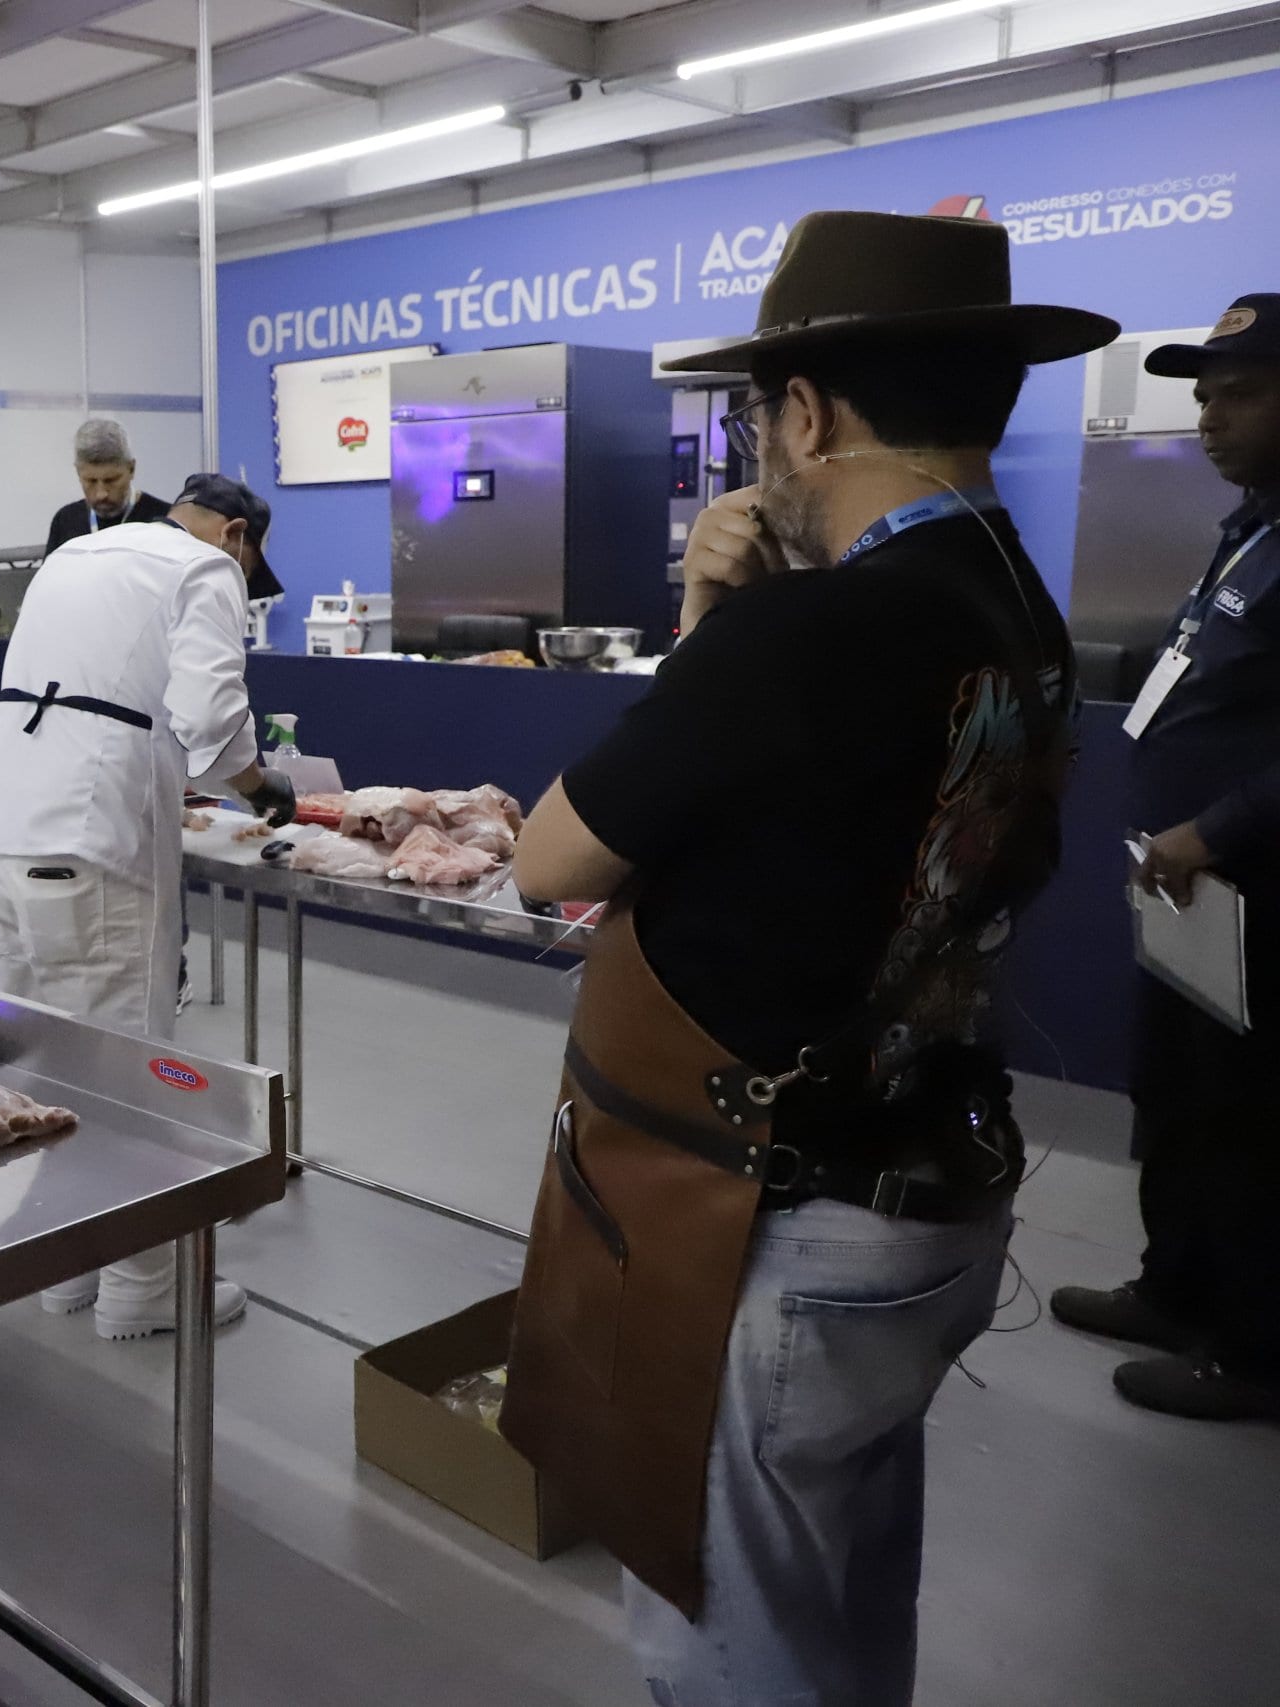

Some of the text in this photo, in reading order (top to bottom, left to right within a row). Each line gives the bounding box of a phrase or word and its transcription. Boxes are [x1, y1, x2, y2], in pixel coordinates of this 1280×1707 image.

[1002, 172, 1236, 217] CONGRESSO CONEXÕES COM
[1003, 190, 1233, 245] RESULTADOS
[699, 221, 789, 276] ACA
[247, 258, 658, 357] OFICINAS TÉCNICAS
[159, 1060, 196, 1085] imeca
